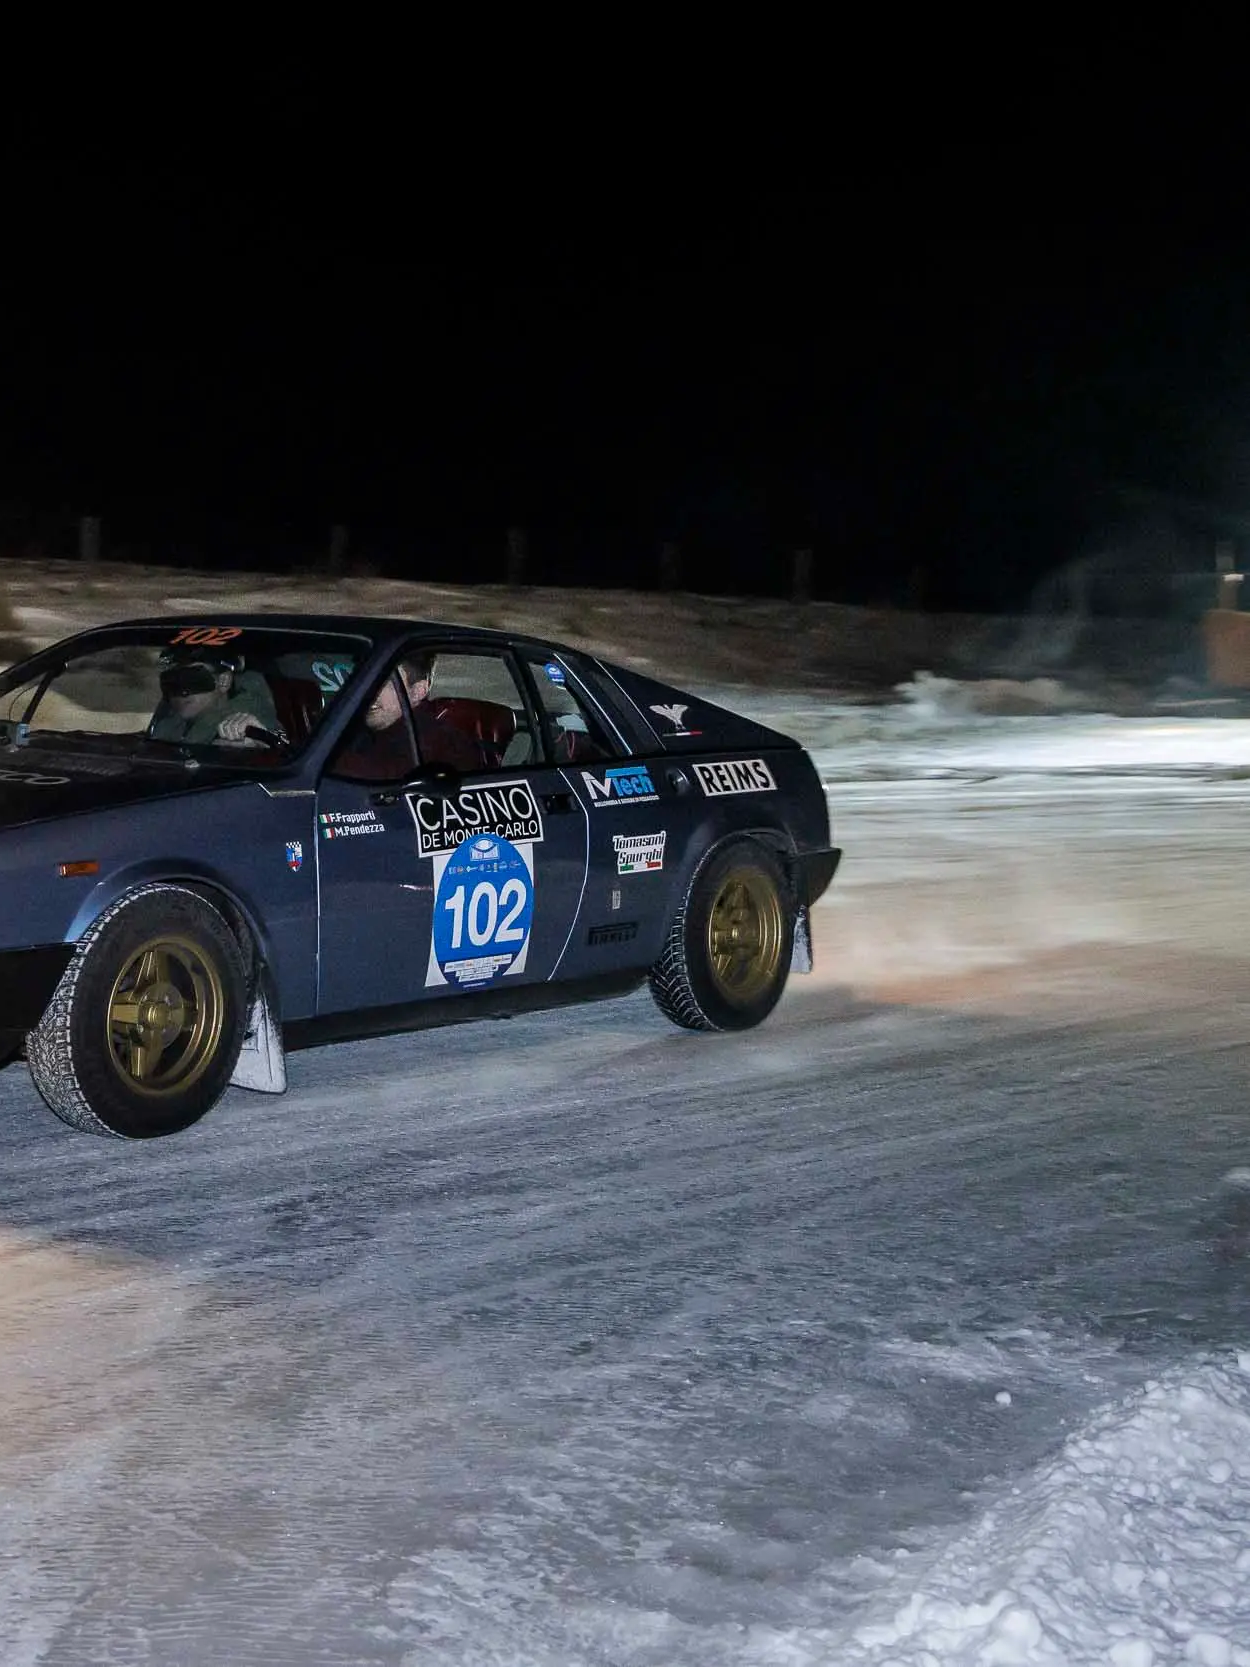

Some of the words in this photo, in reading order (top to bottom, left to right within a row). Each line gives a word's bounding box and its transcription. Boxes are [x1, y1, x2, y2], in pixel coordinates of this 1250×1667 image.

[169, 627, 243, 646] 102
[697, 761, 771, 793] REIMS
[328, 810, 376, 824] F.Frapporti
[416, 787, 533, 831] CASINO
[334, 823, 385, 837] M.Pendezza
[422, 832, 441, 849] DE
[445, 878, 527, 949] 102
